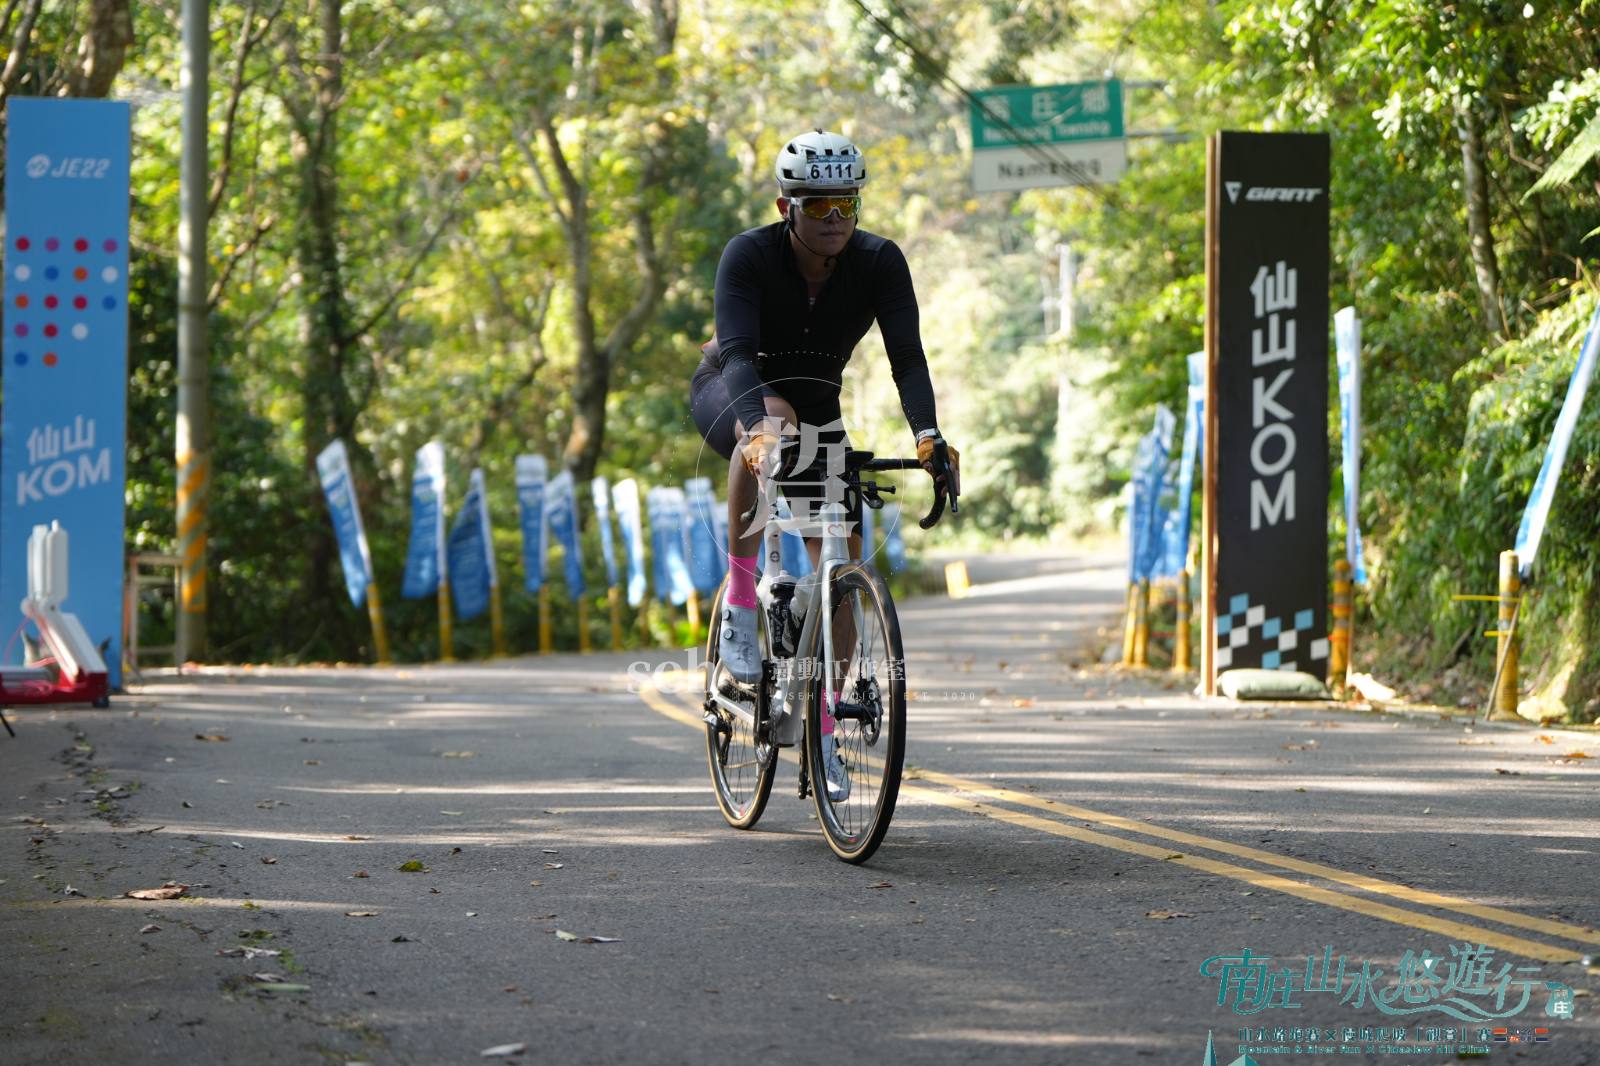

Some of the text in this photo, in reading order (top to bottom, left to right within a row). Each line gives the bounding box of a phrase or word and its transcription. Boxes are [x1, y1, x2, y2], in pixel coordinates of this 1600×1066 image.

[51, 157, 110, 178] JE22
[1245, 187, 1322, 202] GIANT
[1250, 260, 1297, 367] 仙山
[26, 414, 95, 465] 仙山
[1250, 368, 1297, 531] KOM
[17, 447, 111, 506] KOM
